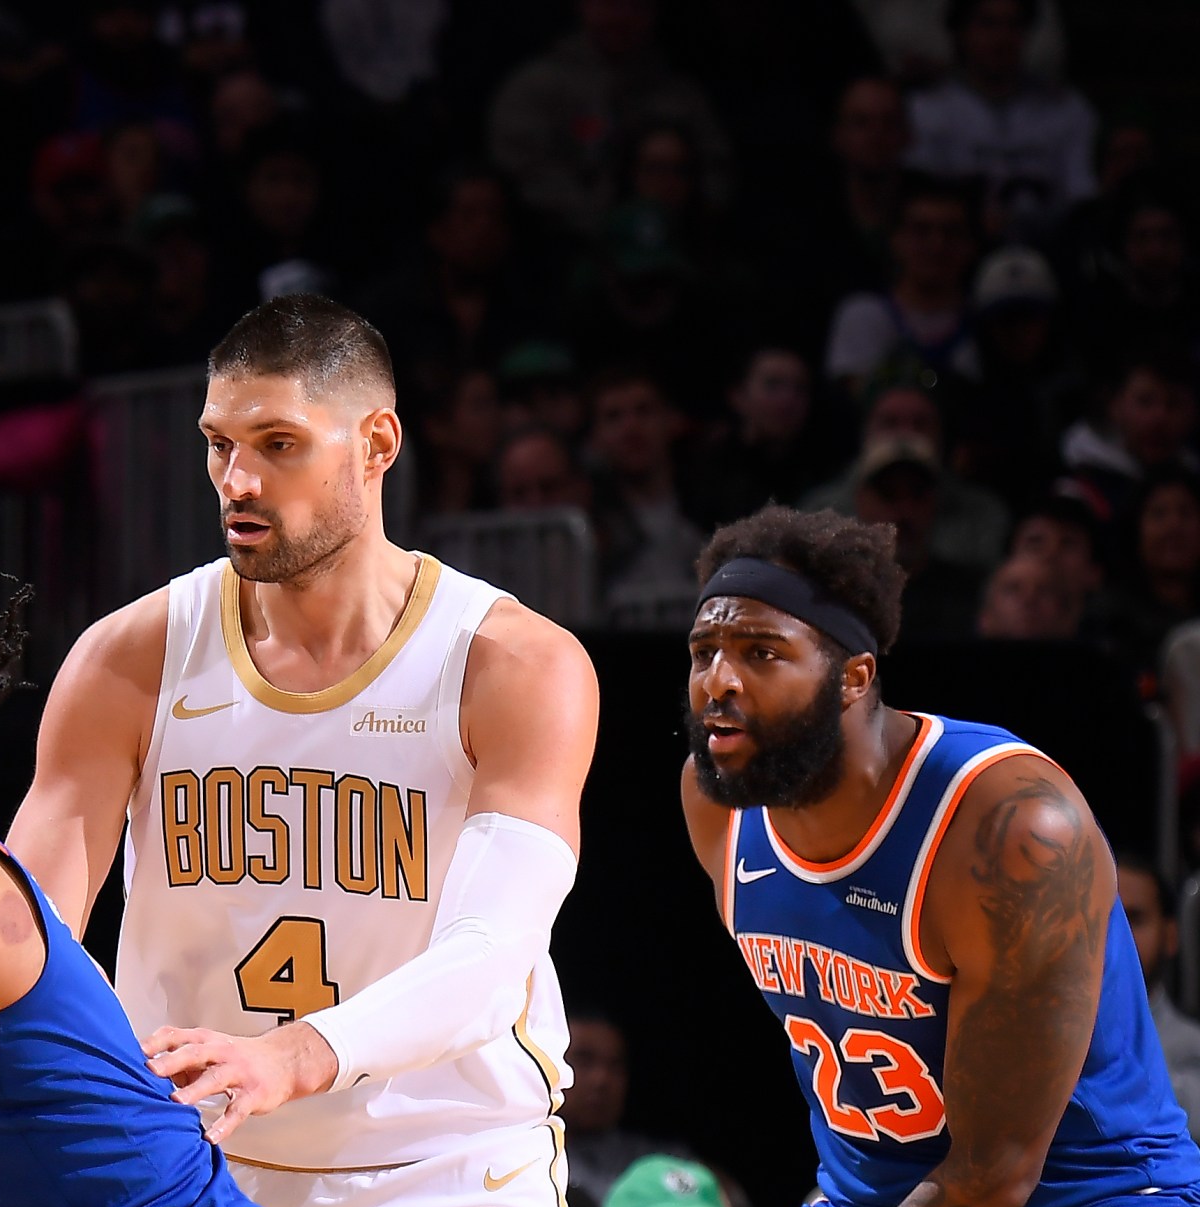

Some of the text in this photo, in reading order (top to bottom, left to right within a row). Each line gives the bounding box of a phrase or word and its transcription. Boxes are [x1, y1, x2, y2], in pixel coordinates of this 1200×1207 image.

[353, 710, 427, 734] Amica
[160, 765, 429, 902] BOSTON
[234, 916, 340, 1027] 4
[735, 932, 937, 1020] NEW YORK
[784, 1014, 947, 1144] 23
